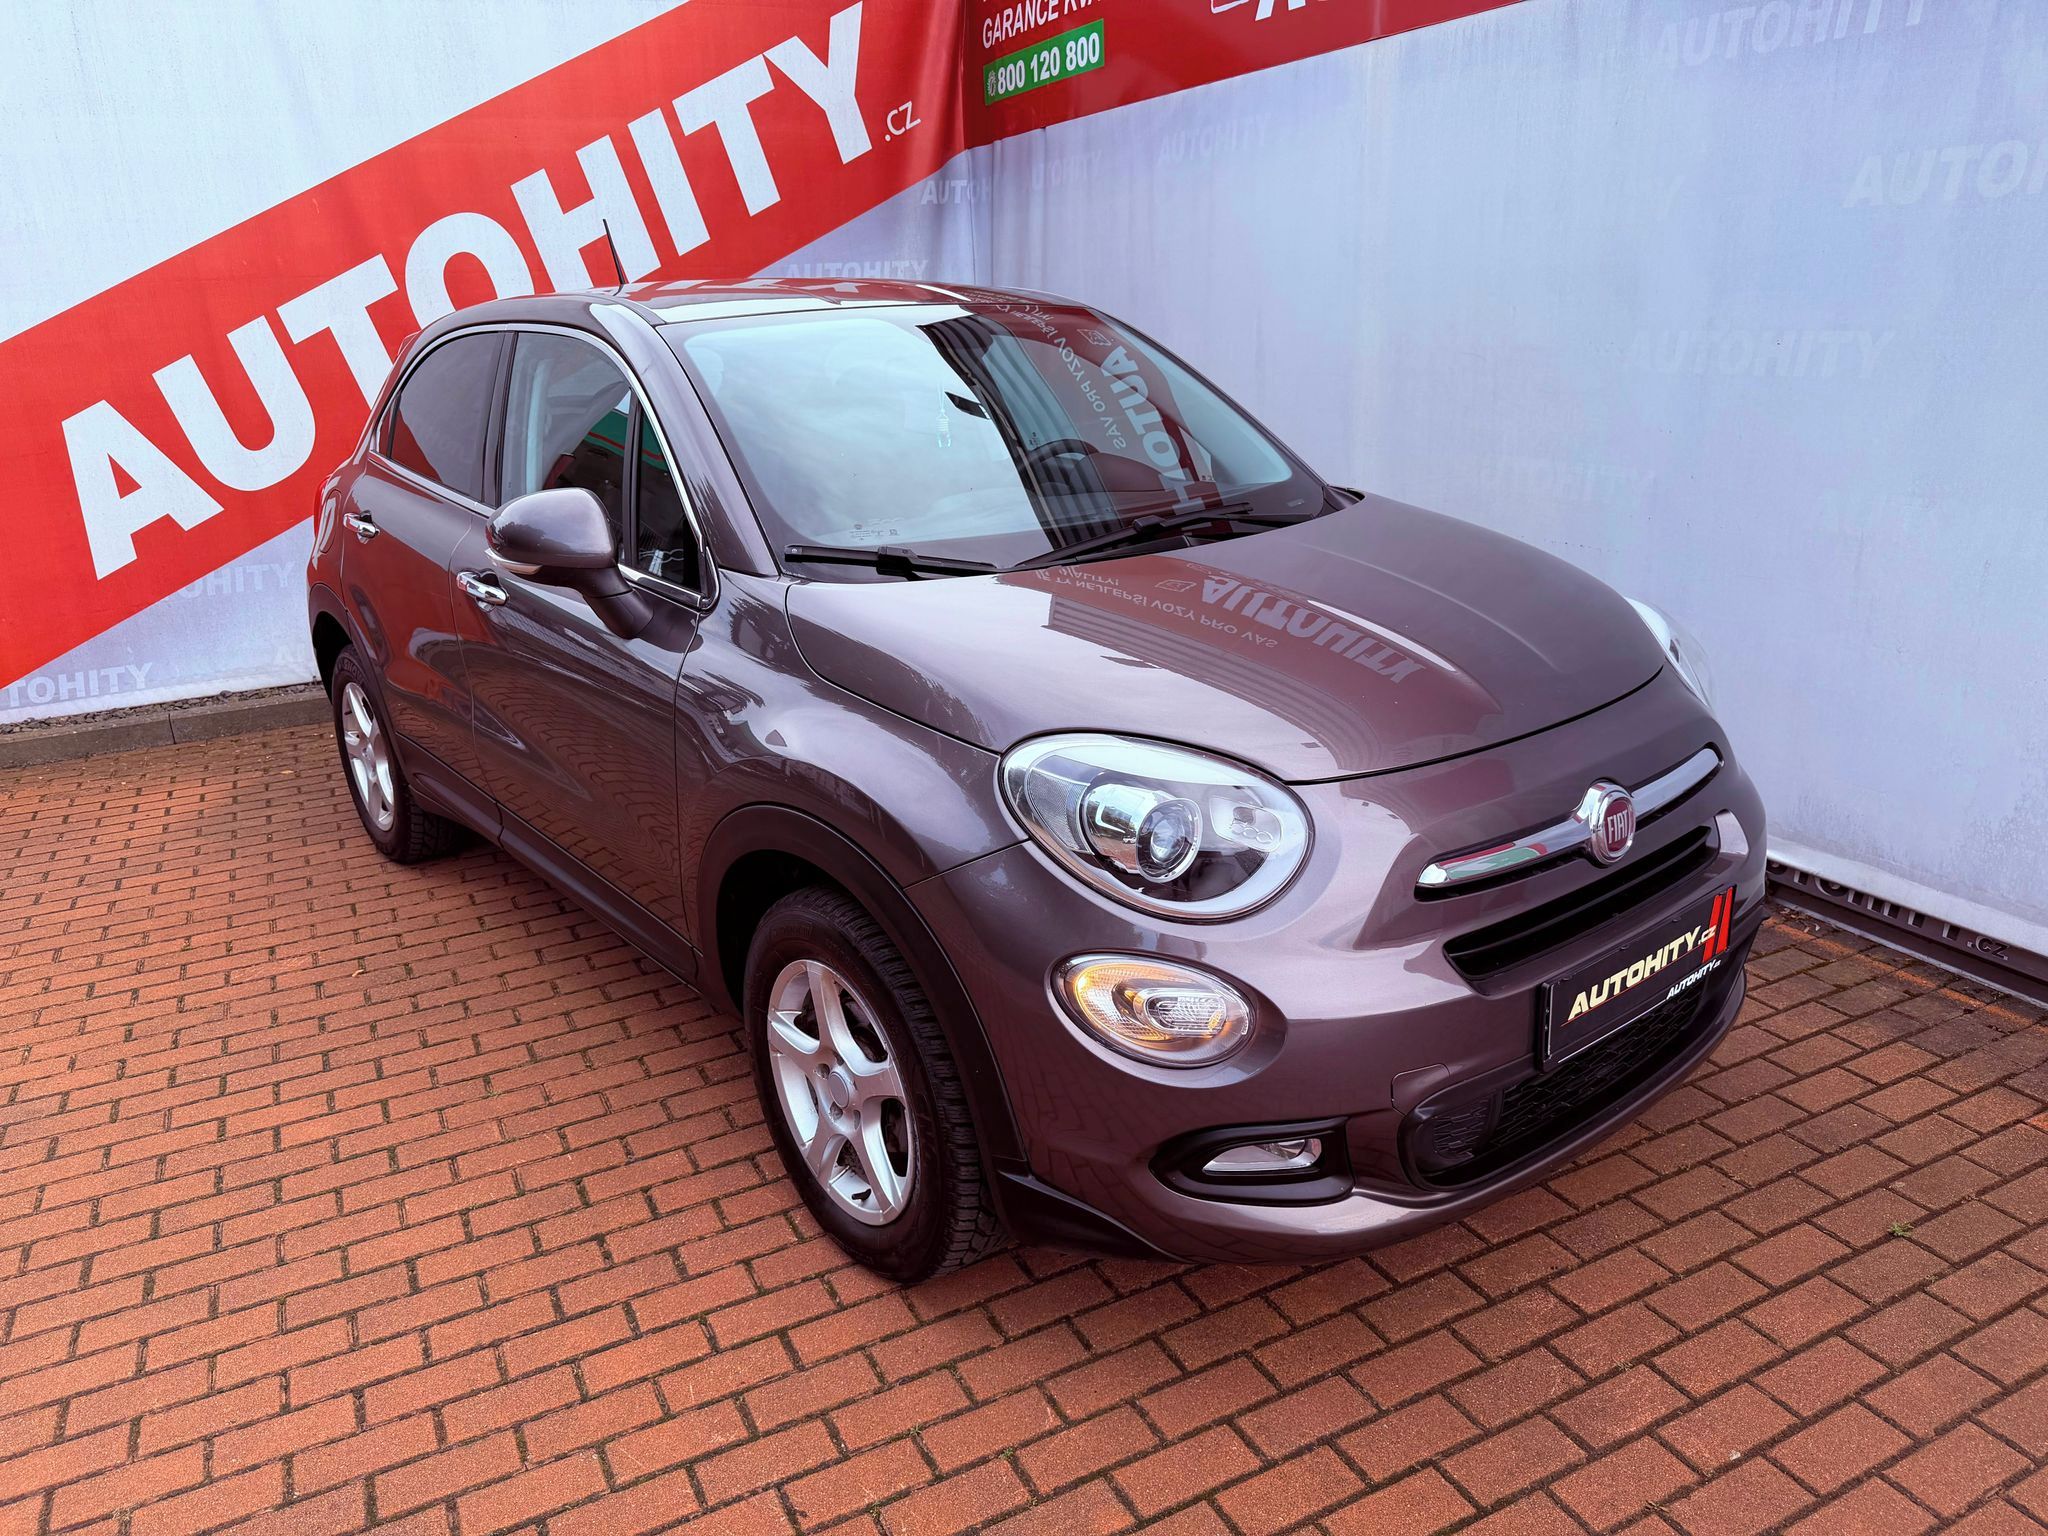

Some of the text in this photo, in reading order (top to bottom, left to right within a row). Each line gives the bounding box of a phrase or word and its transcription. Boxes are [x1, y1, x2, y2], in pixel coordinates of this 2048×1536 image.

[982, 0, 1059, 49] GARANCE
[997, 32, 1100, 95] 800 120 800
[1607, 809, 1628, 844] FIAT
